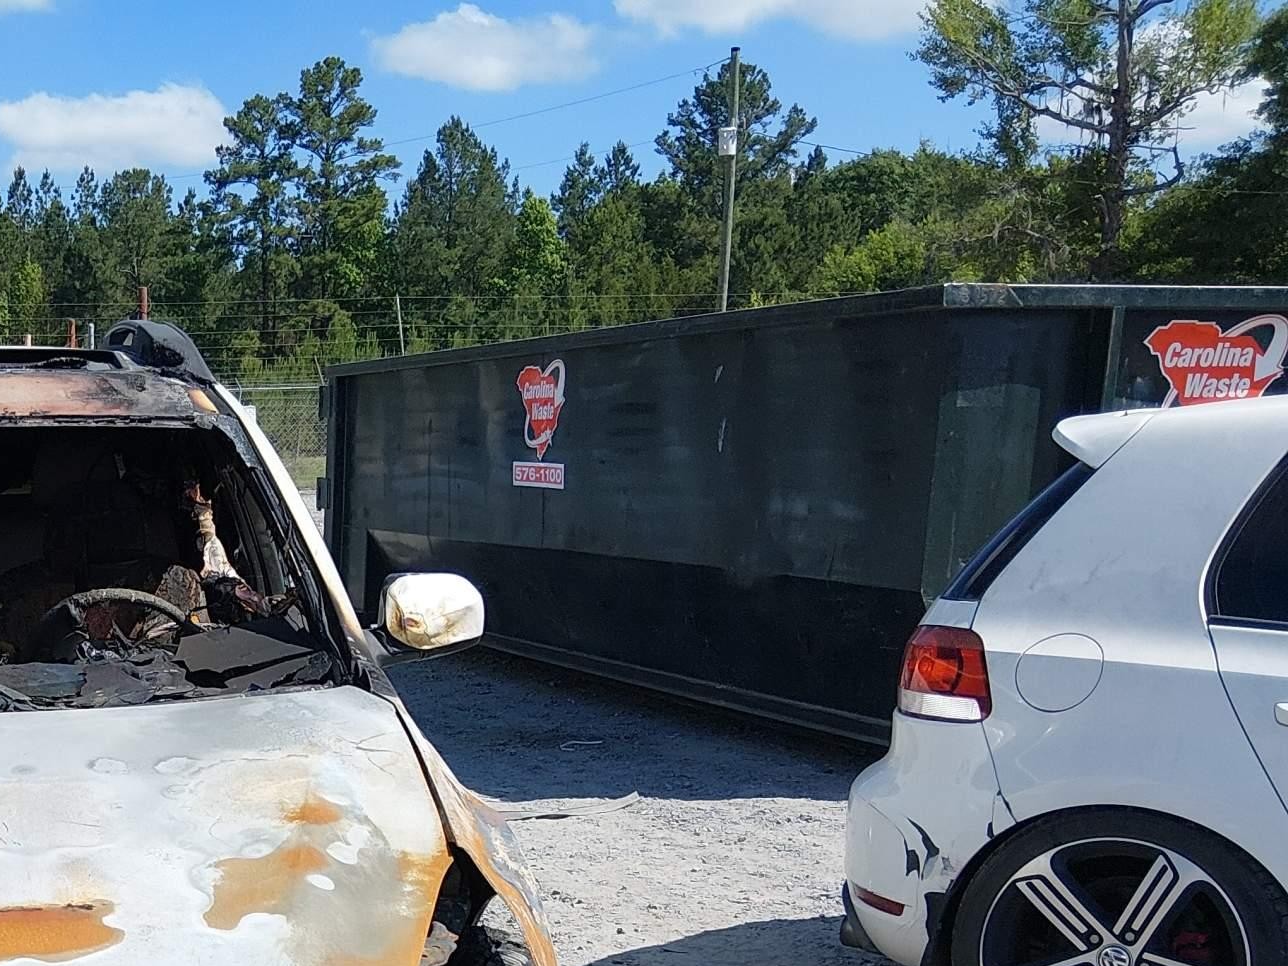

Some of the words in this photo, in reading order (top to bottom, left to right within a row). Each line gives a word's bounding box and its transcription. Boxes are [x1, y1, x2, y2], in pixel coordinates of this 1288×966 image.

[1164, 341, 1254, 368] Carolina
[523, 381, 554, 400] Carolina
[1184, 373, 1251, 398] Waste
[531, 402, 554, 421] Waste
[515, 466, 562, 483] 576-1100
